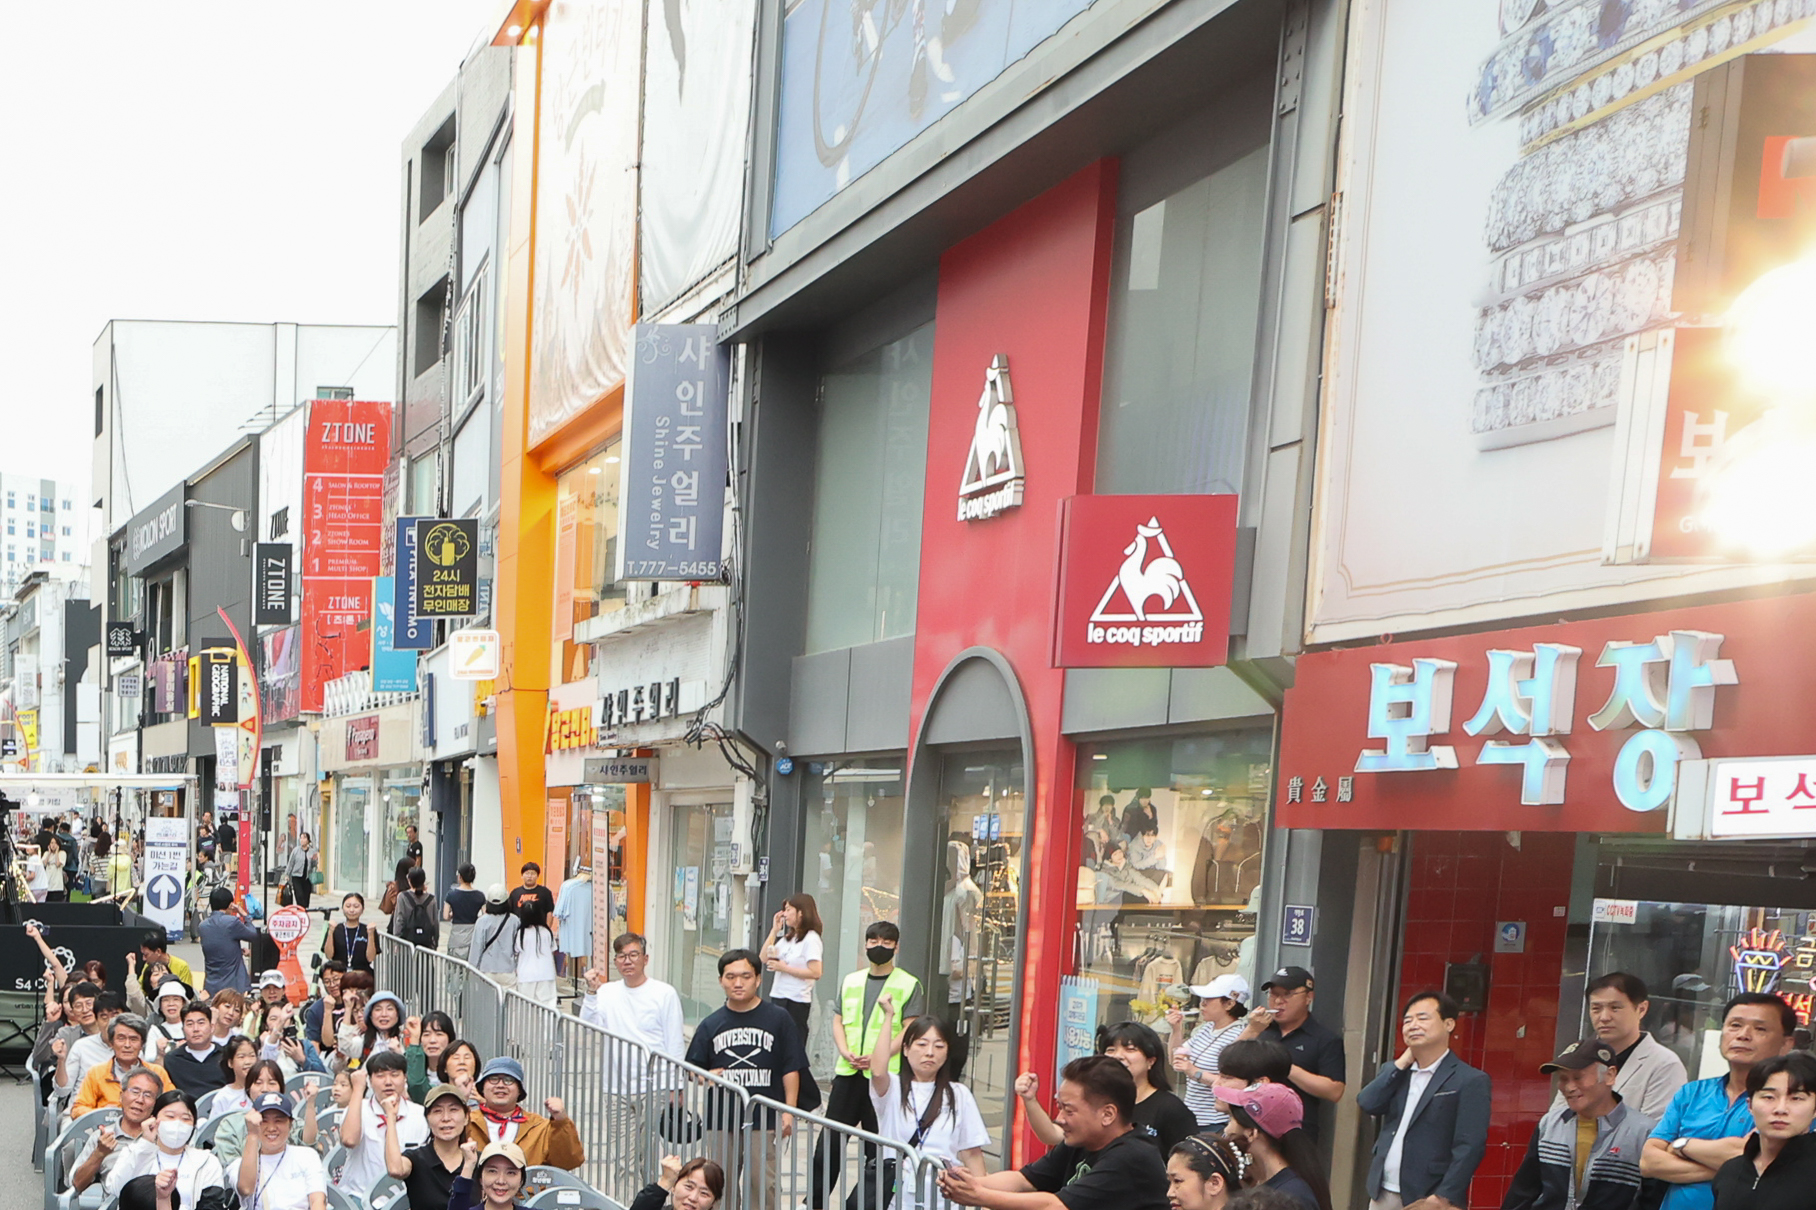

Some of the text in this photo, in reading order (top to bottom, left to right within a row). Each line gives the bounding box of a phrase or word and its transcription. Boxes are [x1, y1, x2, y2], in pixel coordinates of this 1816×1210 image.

[322, 422, 376, 444] ZTONE
[668, 335, 712, 551] 샤인주얼리
[313, 477, 323, 493] 4
[646, 415, 670, 551] Shine Jewelry
[984, 480, 1015, 517] sportif
[313, 503, 323, 519] 3
[312, 529, 322, 545] 2
[312, 558, 320, 573] 1
[432, 568, 461, 583] 24시
[268, 557, 286, 610] ZTONE
[423, 584, 470, 598] 전자담배
[328, 596, 361, 609] ZTONE
[422, 598, 471, 613] 무인매장
[1087, 621, 1204, 647] le coq sportif
[211, 663, 220, 717] GEOGRAPHIC
[220, 664, 229, 707] NATIONAL
[601, 676, 680, 731] 샤인주얼리
[1354, 629, 1740, 813] 보석장
[599, 764, 647, 776] 샤인주얼리
[1290, 917, 1305, 936] 38
[712, 1027, 775, 1054] UNIVERSITY OF
